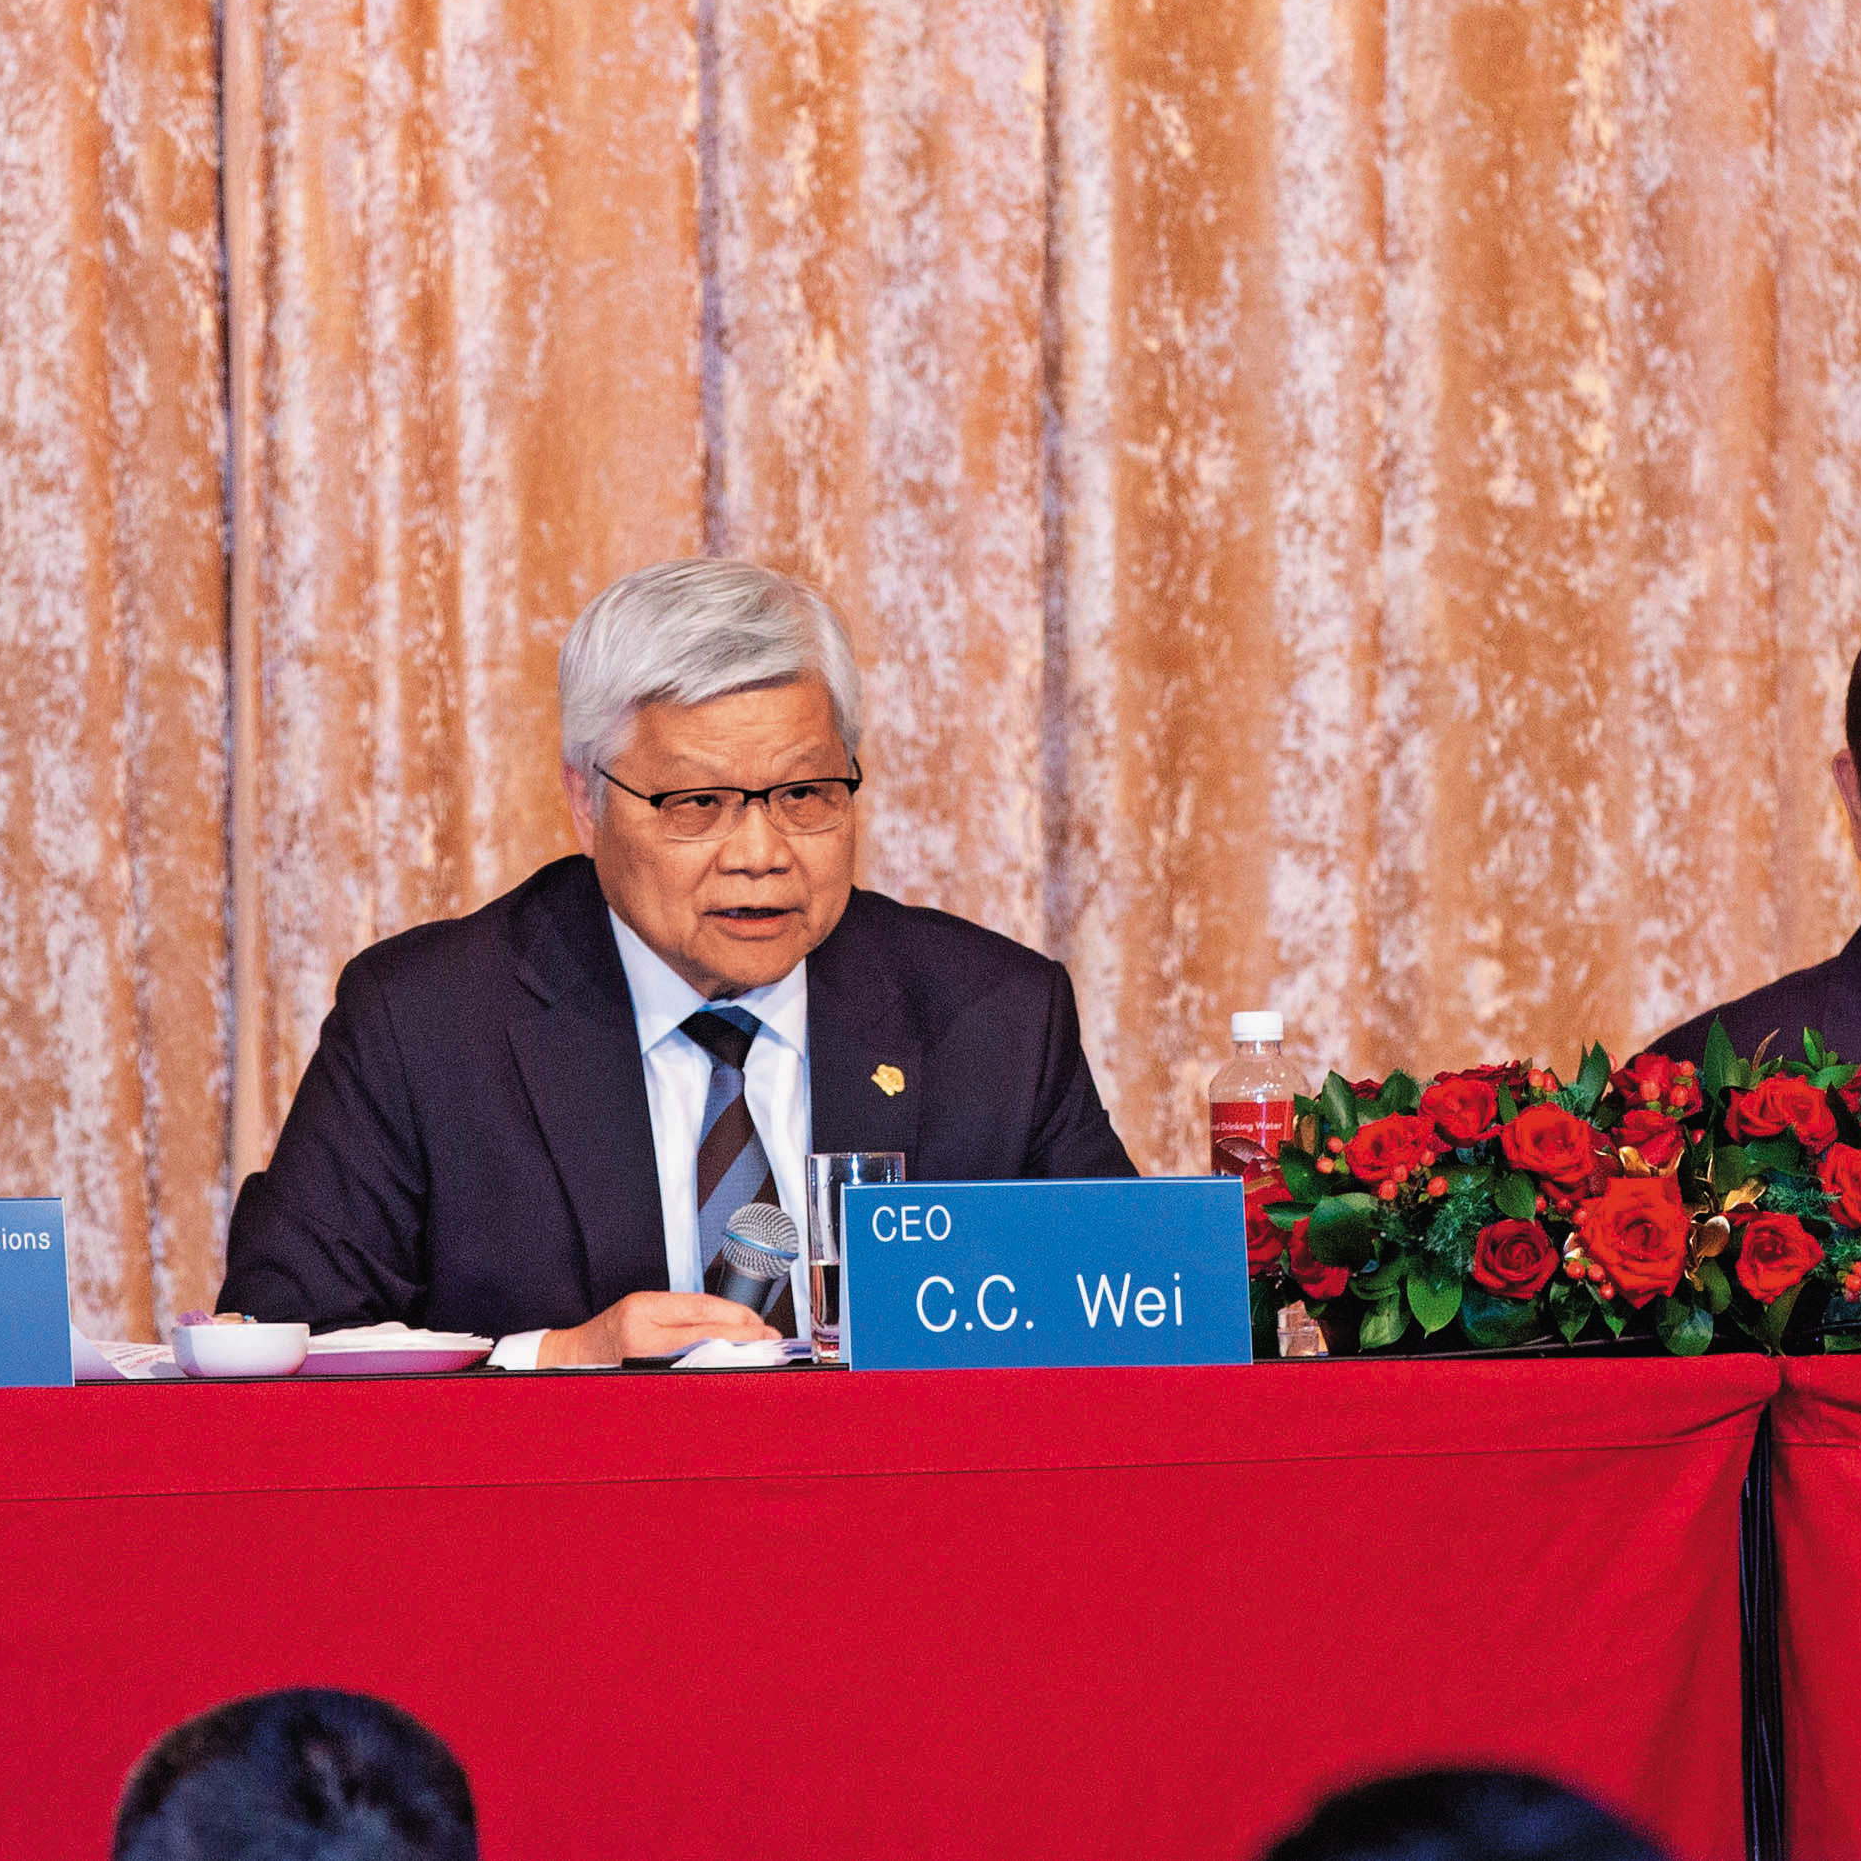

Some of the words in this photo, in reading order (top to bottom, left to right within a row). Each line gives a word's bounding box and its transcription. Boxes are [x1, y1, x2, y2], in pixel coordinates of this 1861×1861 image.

[1221, 1121, 1253, 1132] Drinking
[1255, 1121, 1283, 1131] Water
[872, 1204, 952, 1243] CEO
[916, 1273, 1035, 1333] C.C.
[1076, 1271, 1183, 1329] Wei
